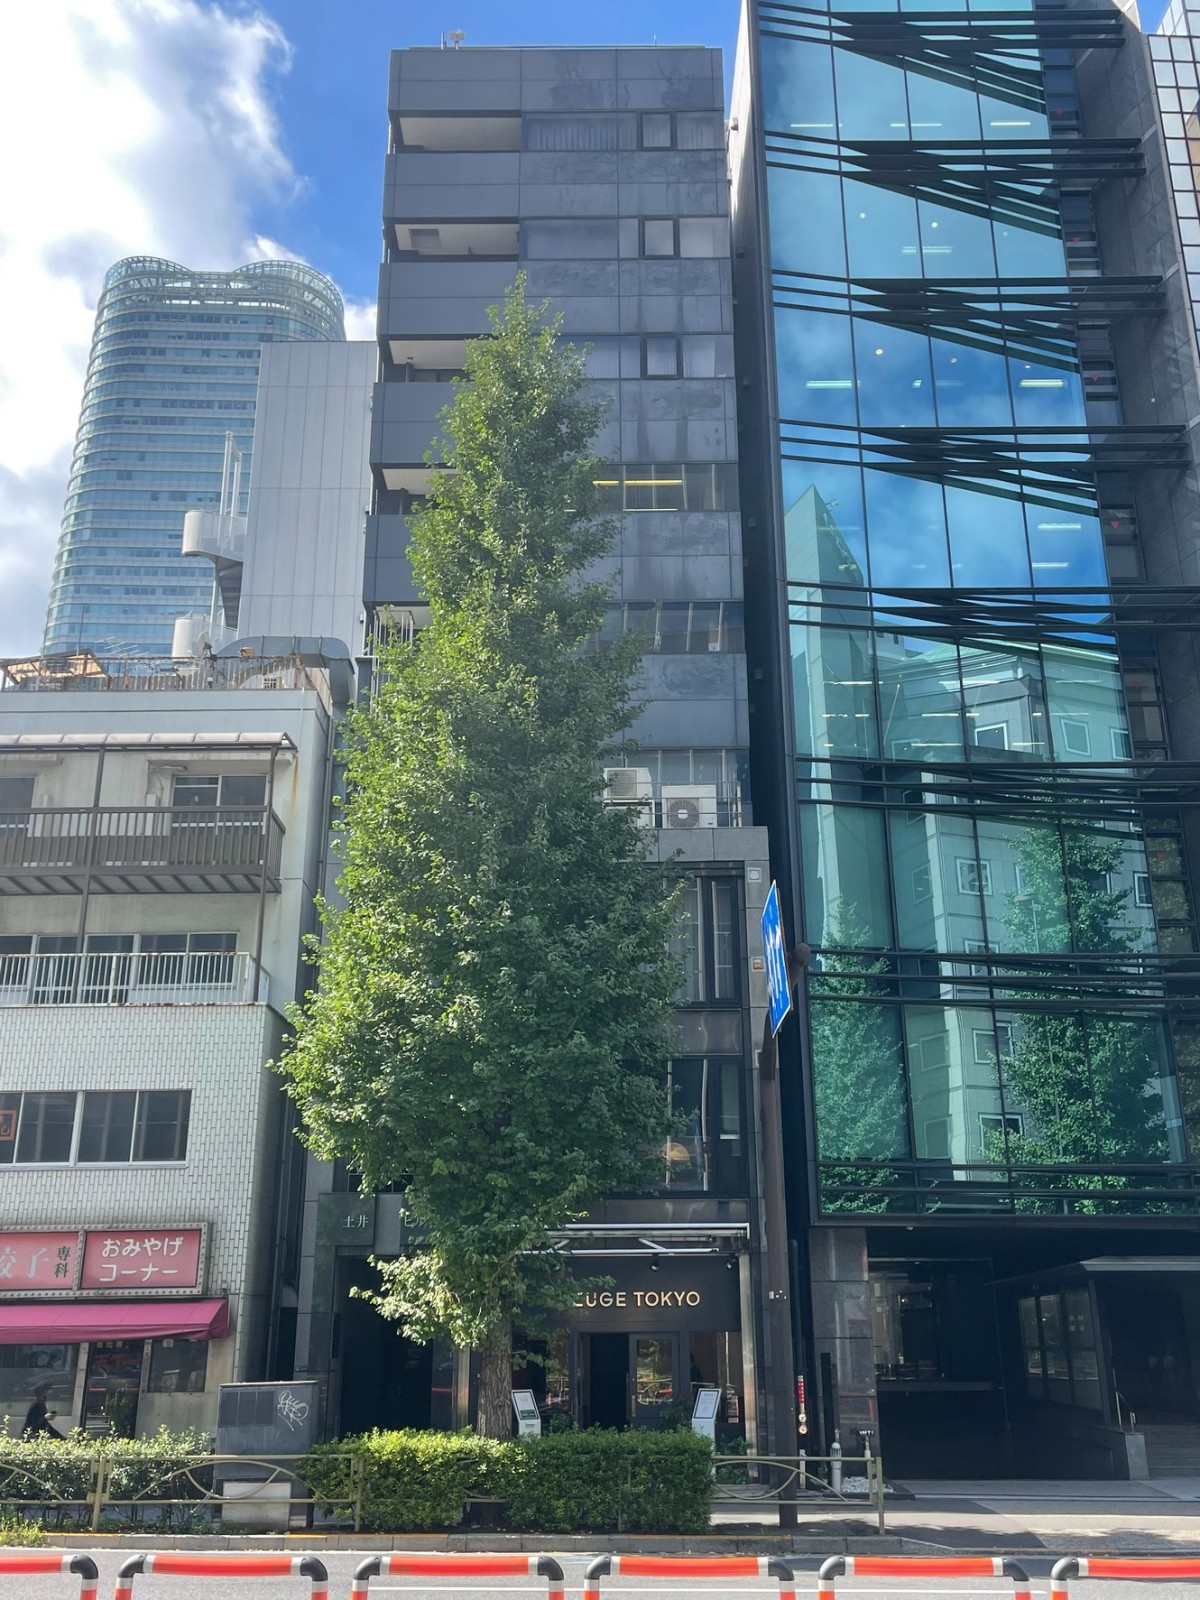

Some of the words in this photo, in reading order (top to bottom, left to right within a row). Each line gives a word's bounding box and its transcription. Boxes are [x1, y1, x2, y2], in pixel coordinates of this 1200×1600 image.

[101, 1236, 184, 1257] おみやげ
[99, 1262, 178, 1282] コーナー
[633, 1291, 701, 1307] TOKYO
